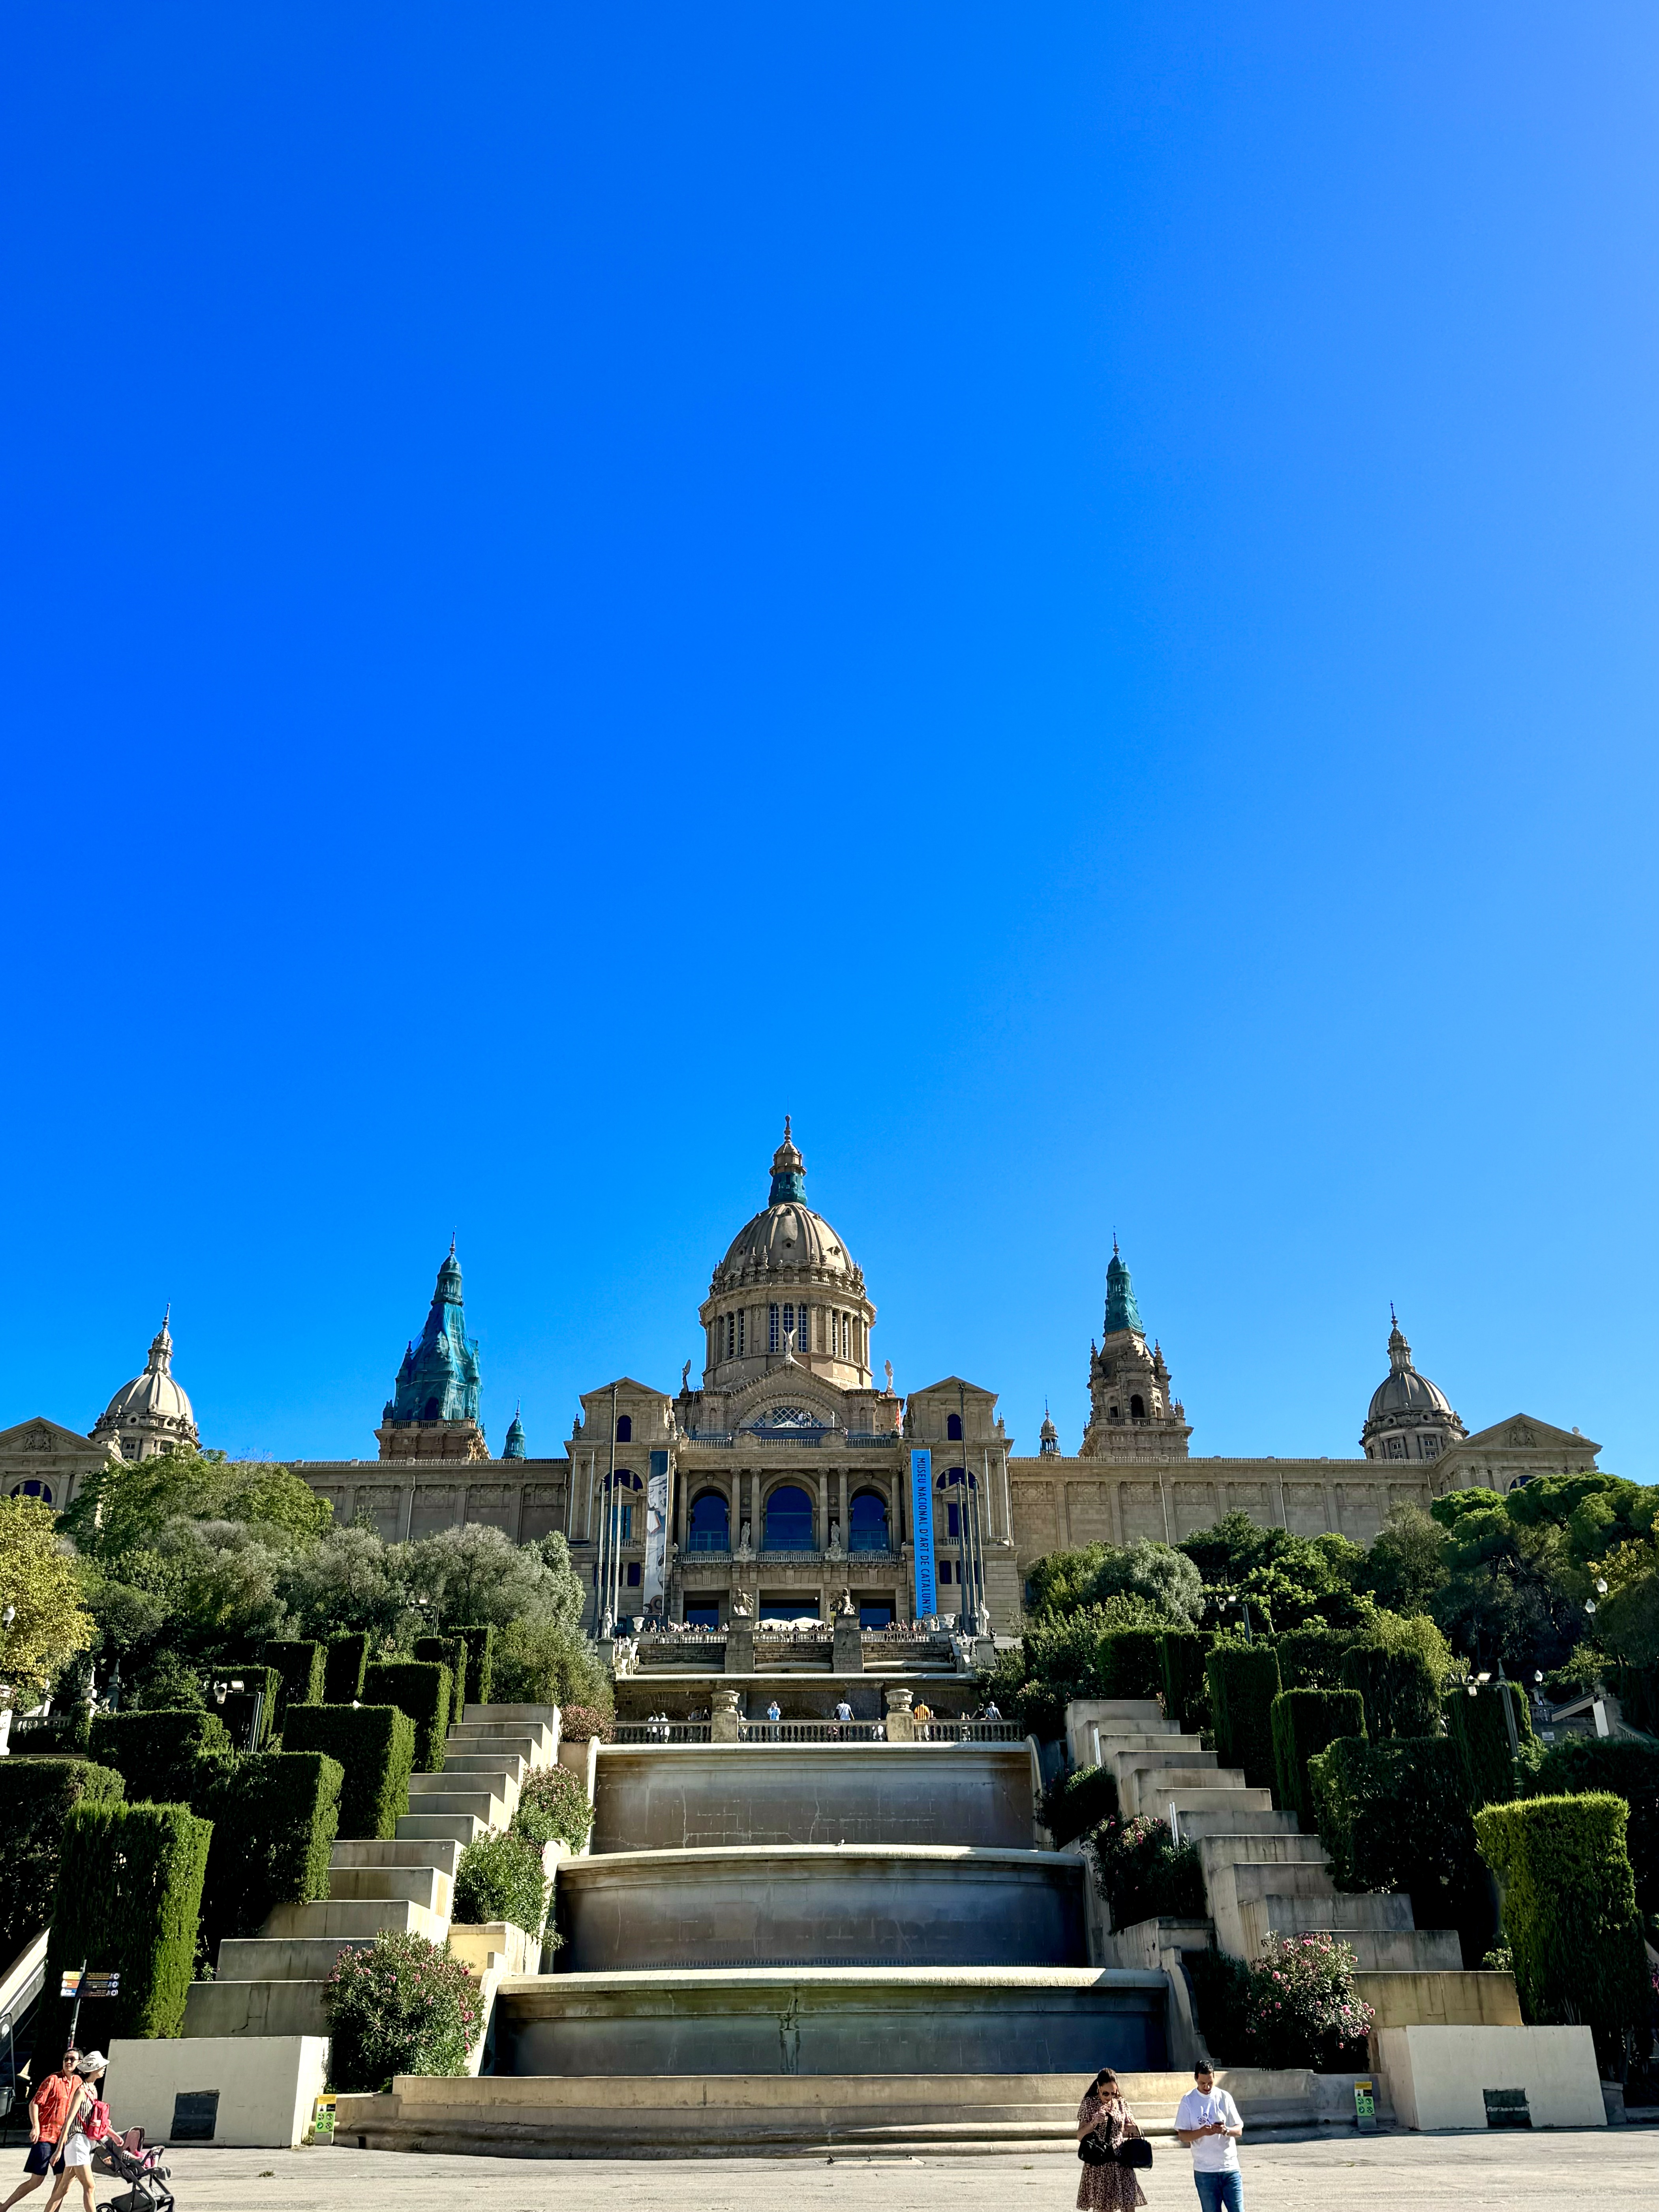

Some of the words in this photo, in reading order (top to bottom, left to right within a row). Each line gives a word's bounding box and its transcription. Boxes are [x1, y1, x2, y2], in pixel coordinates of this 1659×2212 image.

[917, 1458, 926, 1483] MUSEU
[918, 1487, 928, 1525] NACIONAL
[919, 1529, 929, 1552] D'ART
[920, 1556, 929, 1565] DE
[921, 1569, 931, 1615] CATALUNYA
